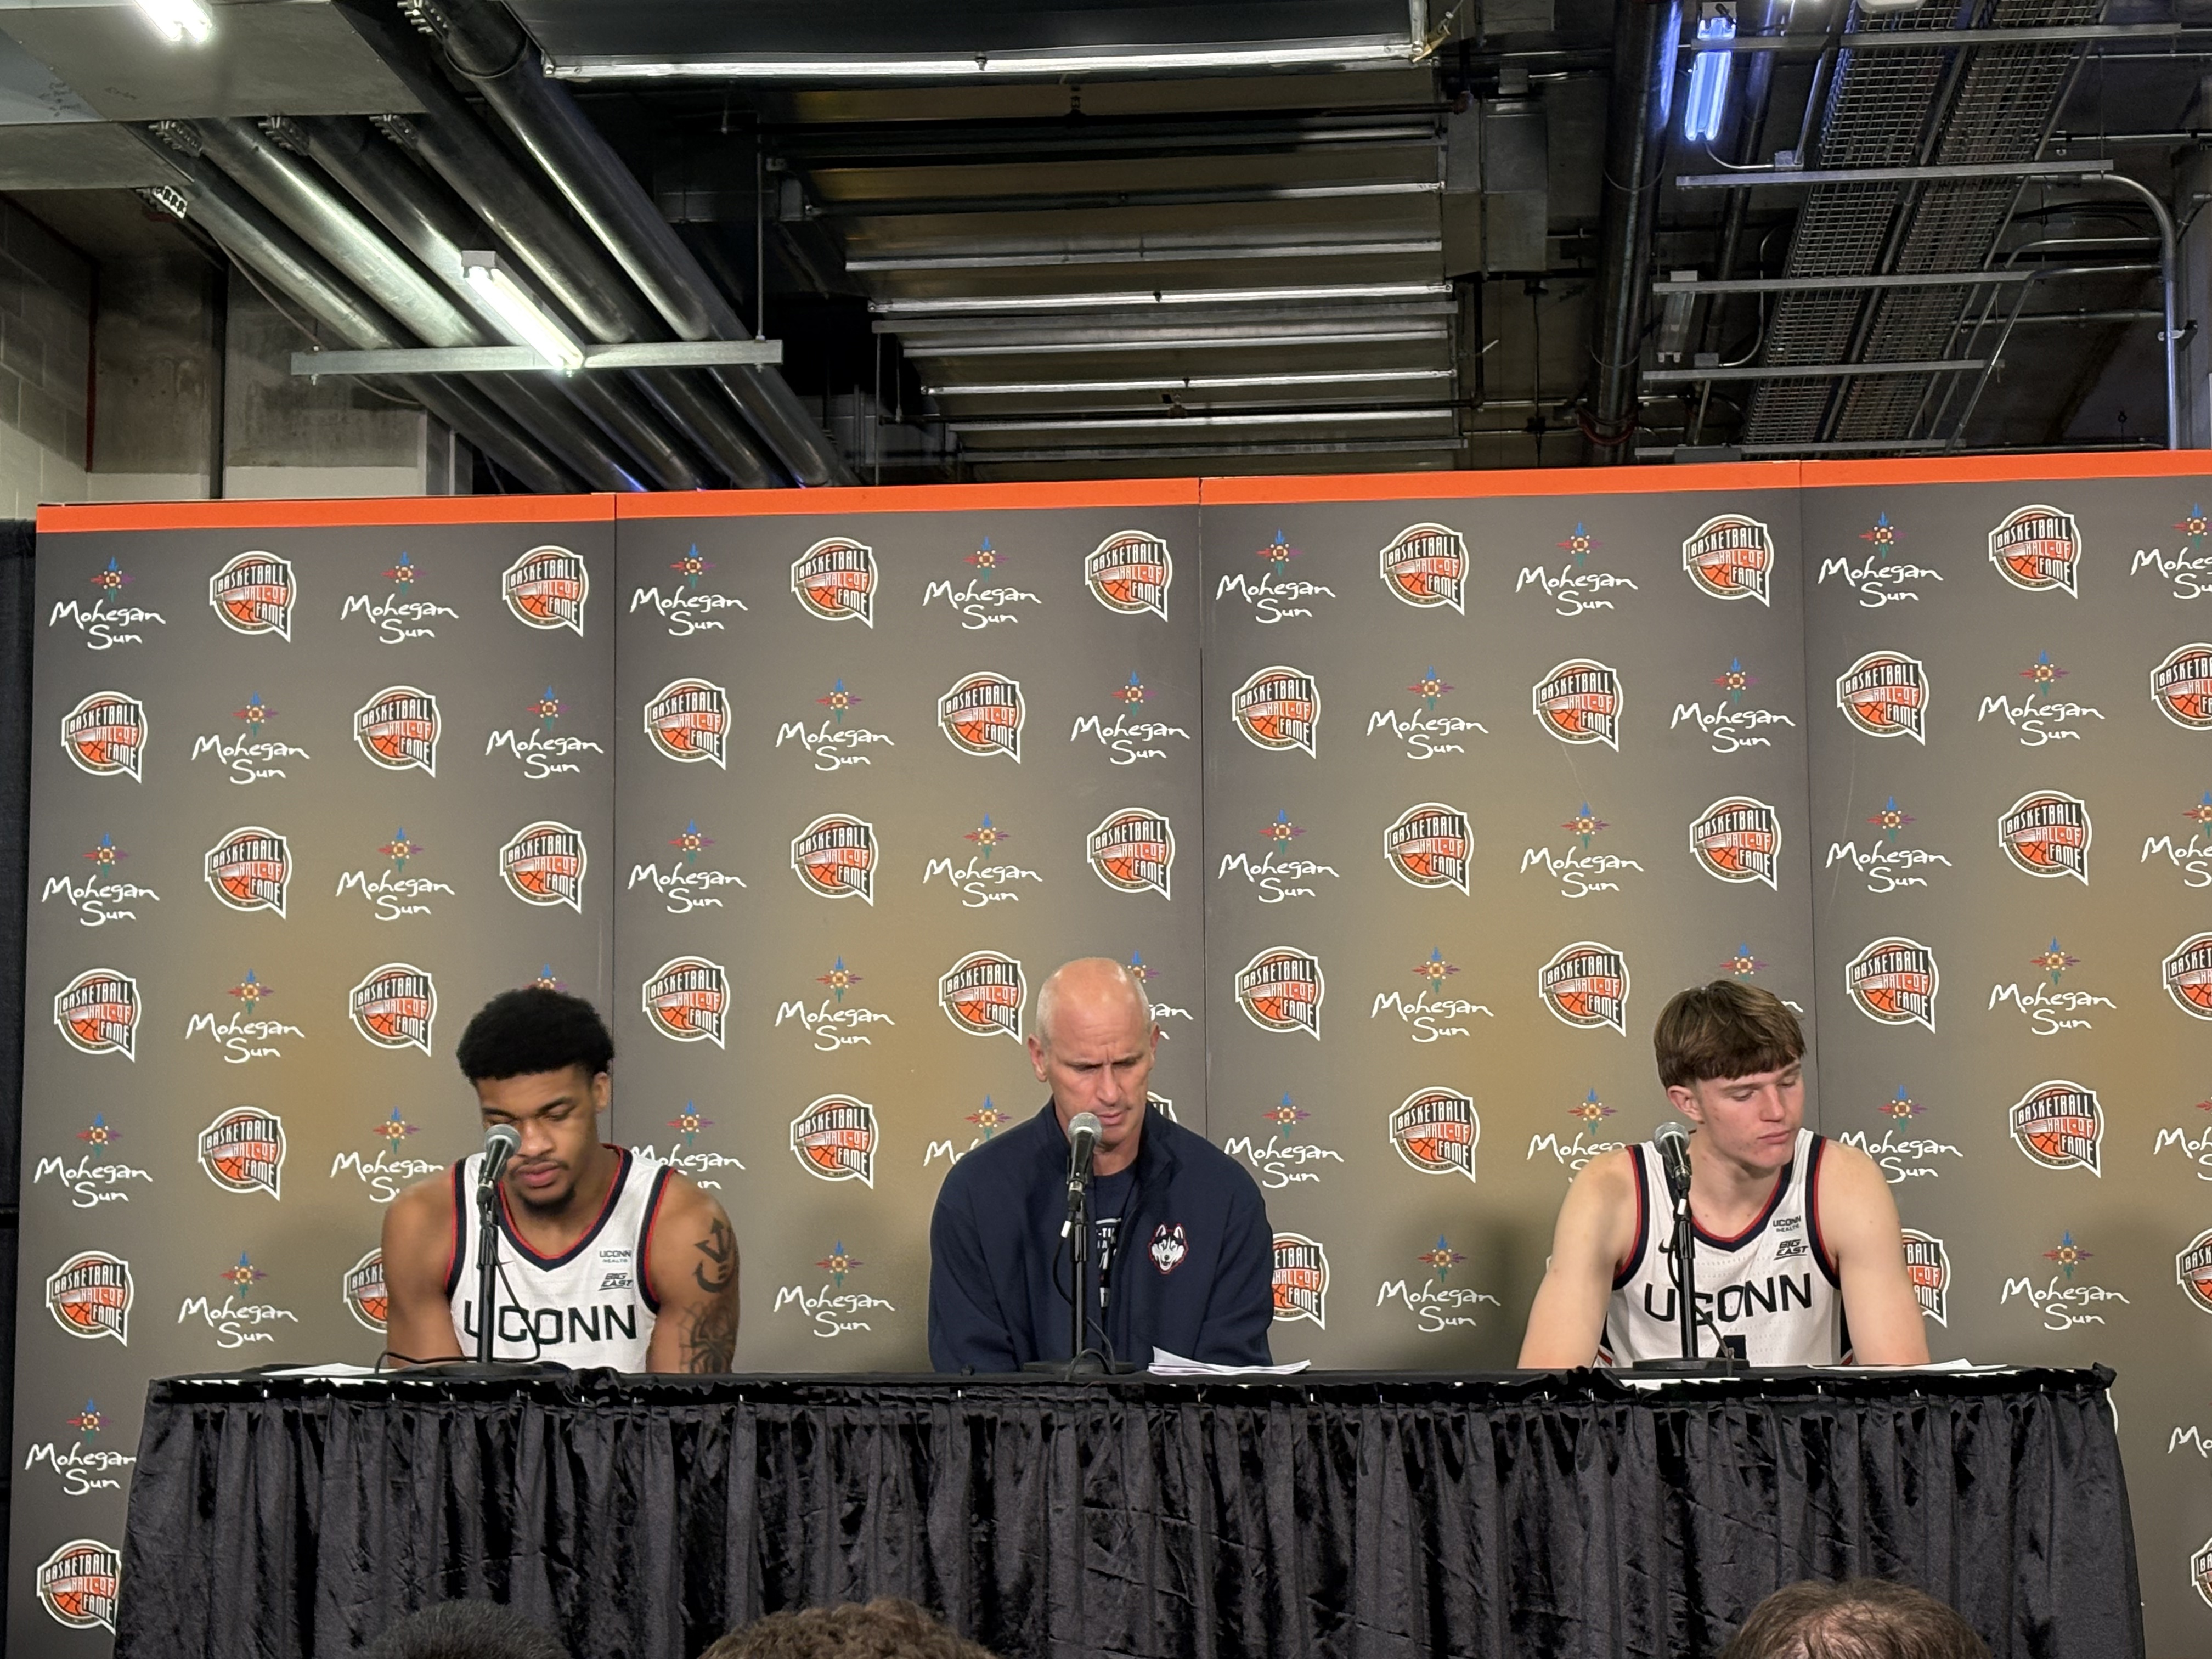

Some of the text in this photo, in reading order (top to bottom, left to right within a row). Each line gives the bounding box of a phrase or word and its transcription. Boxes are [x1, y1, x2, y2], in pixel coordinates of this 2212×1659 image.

[1691, 527, 1762, 556] BASKETBALL
[1997, 518, 2069, 548] BASKETBALL
[799, 550, 867, 578] BASKETBALL
[1092, 543, 1161, 571] BASKETBALL
[1388, 535, 1458, 565] BASKETBALL
[217, 563, 285, 592] BASKETBALL
[510, 558, 578, 586] BASKETBALL
[1516, 565, 1638, 596] Mohegan
[1731, 566, 1762, 595] FAME
[1818, 556, 1943, 587] Mohegan
[2038, 557, 2069, 586] FAME
[630, 585, 748, 616] Mohegan
[837, 588, 867, 616] FAME
[923, 579, 1041, 609] Mohegan
[1131, 581, 1161, 609] FAME
[1216, 573, 1335, 603] Mohegan
[1427, 574, 1458, 603] FAME
[1860, 582, 1919, 607] Sun
[49, 599, 166, 630] Mohegan
[256, 602, 285, 630] FAME
[341, 594, 459, 624] Mohegan
[549, 596, 578, 624] FAME
[962, 604, 1018, 629] Sun
[1256, 598, 1312, 623] Sun
[1556, 590, 1614, 616] Sun
[87, 624, 142, 650] Sun
[380, 619, 435, 644] Sun
[669, 611, 724, 636] Sun
[1541, 672, 1612, 701] BASKETBALL
[1844, 664, 1917, 693] BASKETBALL
[652, 691, 720, 720] BASKETBALL
[946, 685, 1014, 713] BASKETBALL
[1240, 679, 1309, 708] BASKETBALL
[69, 704, 136, 733] BASKETBALL
[362, 698, 430, 727] BASKETBALL
[1367, 708, 1488, 739] Mohegan
[1671, 701, 1795, 732] Mohegan
[1886, 703, 1917, 732] FAME
[1978, 694, 2105, 725] Mohegan
[776, 720, 894, 751] Mohegan
[984, 723, 1014, 751] FAME
[1070, 714, 1190, 744] Mohegan
[1279, 718, 1309, 746] FAME
[1581, 711, 1612, 740] FAME
[1712, 727, 1770, 753] Sun
[2021, 720, 2080, 746] Sun
[107, 742, 136, 771] FAME
[191, 733, 310, 764] Mohegan
[400, 737, 430, 765] FAME
[486, 729, 603, 759] Mohegan
[690, 729, 720, 758] FAME
[1110, 740, 1166, 765] Sun
[1407, 734, 1464, 759] Sun
[230, 759, 286, 784] Sun
[524, 754, 580, 779] Sun
[815, 746, 871, 771] Sun
[1392, 816, 1462, 845] BASKETBALL
[1698, 809, 1769, 839] BASKETBALL
[2006, 803, 2080, 833] BASKETBALL
[507, 834, 575, 863] BASKETBALL
[799, 826, 867, 855] BASKETBALL
[1095, 820, 1164, 850] BASKETBALL
[212, 839, 280, 868] BASKETBALL
[1218, 851, 1339, 882] Mohegan
[1520, 846, 1644, 877] Mohegan
[1739, 849, 1769, 878] FAME
[1826, 840, 1952, 872] Mohegan
[2048, 843, 2080, 873] FAME
[628, 862, 747, 893] Mohegan
[837, 865, 867, 894] FAME
[923, 856, 1042, 887] Mohegan
[1134, 860, 1164, 888] FAME
[1431, 855, 1462, 883] FAME
[1868, 867, 1927, 893] Sun
[42, 874, 160, 906] Mohegan
[251, 878, 280, 907] FAME
[336, 870, 455, 900] Mohegan
[546, 873, 575, 901] FAME
[962, 882, 1018, 907] Sun
[1259, 877, 1315, 903] Sun
[1561, 872, 1620, 898] Sun
[80, 900, 136, 926] Sun
[375, 895, 431, 921] Sun
[667, 888, 723, 913] Sun
[947, 963, 1015, 993] BASKETBALL
[1244, 960, 1313, 989] BASKETBALL
[1547, 955, 1618, 985] BASKETBALL
[1854, 950, 1927, 981] BASKETBALL
[61, 981, 130, 1011] BASKETBALL
[357, 976, 426, 1005] BASKETBALL
[650, 969, 719, 998] BASKETBALL
[1988, 983, 2117, 1013] Mohegan
[775, 1000, 895, 1030] Mohegan
[986, 1003, 1015, 1031] FAME
[1283, 999, 1313, 1028] FAME
[1371, 991, 1494, 1021] Mohegan
[1587, 995, 1618, 1024] FAME
[1895, 991, 1927, 1020] FAME
[100, 1020, 130, 1049] FAME
[185, 1012, 304, 1043] Mohegan
[396, 1015, 426, 1043] FAME
[689, 1008, 719, 1037] FAME
[1412, 1017, 1470, 1042] Sun
[2032, 1009, 2092, 1035] Sun
[224, 1037, 280, 1063] Sun
[815, 1025, 871, 1051] Sun
[798, 1108, 867, 1137] BASKETBALL
[1397, 1100, 1468, 1130] BASKETBALL
[2018, 1094, 2092, 1125] BASKETBALL
[206, 1119, 275, 1149] BASKETBALL
[1839, 1130, 1963, 1159] Mohegan
[837, 1147, 867, 1176] FAME
[1224, 1136, 1344, 1167] Mohegan
[1437, 1140, 1468, 1170] FAME
[2059, 1135, 2092, 1165] FAME
[33, 1155, 153, 1187] Mohegan
[245, 1159, 275, 1188] FAME
[1262, 1162, 1320, 1188] Sun
[1880, 1157, 1938, 1183] Sun
[72, 1181, 128, 1208] Sun
[1773, 1215, 1802, 1227] UCONN
[1776, 1245, 1809, 1256] EAST
[1779, 1239, 1802, 1249] BIG
[53, 1264, 122, 1294] BASKETBALL
[601, 1279, 633, 1288] EAST
[2001, 1276, 2130, 1308] Mohegan
[774, 1285, 895, 1316] Mohegan
[1288, 1286, 1319, 1316] FAME
[1376, 1279, 1500, 1311] Mohegan
[1645, 1273, 1812, 1326] UCONN
[92, 1304, 122, 1334] FAME
[178, 1295, 298, 1327] Mohegan
[814, 1311, 871, 1337] Sun
[1418, 1306, 1476, 1332] Sun
[2044, 1304, 2105, 1330] Sun
[217, 1322, 274, 1348] Sun
[64, 1468, 120, 1495] Sun
[46, 1553, 113, 1583] BASKETBALL
[83, 1594, 112, 1624] FAME
